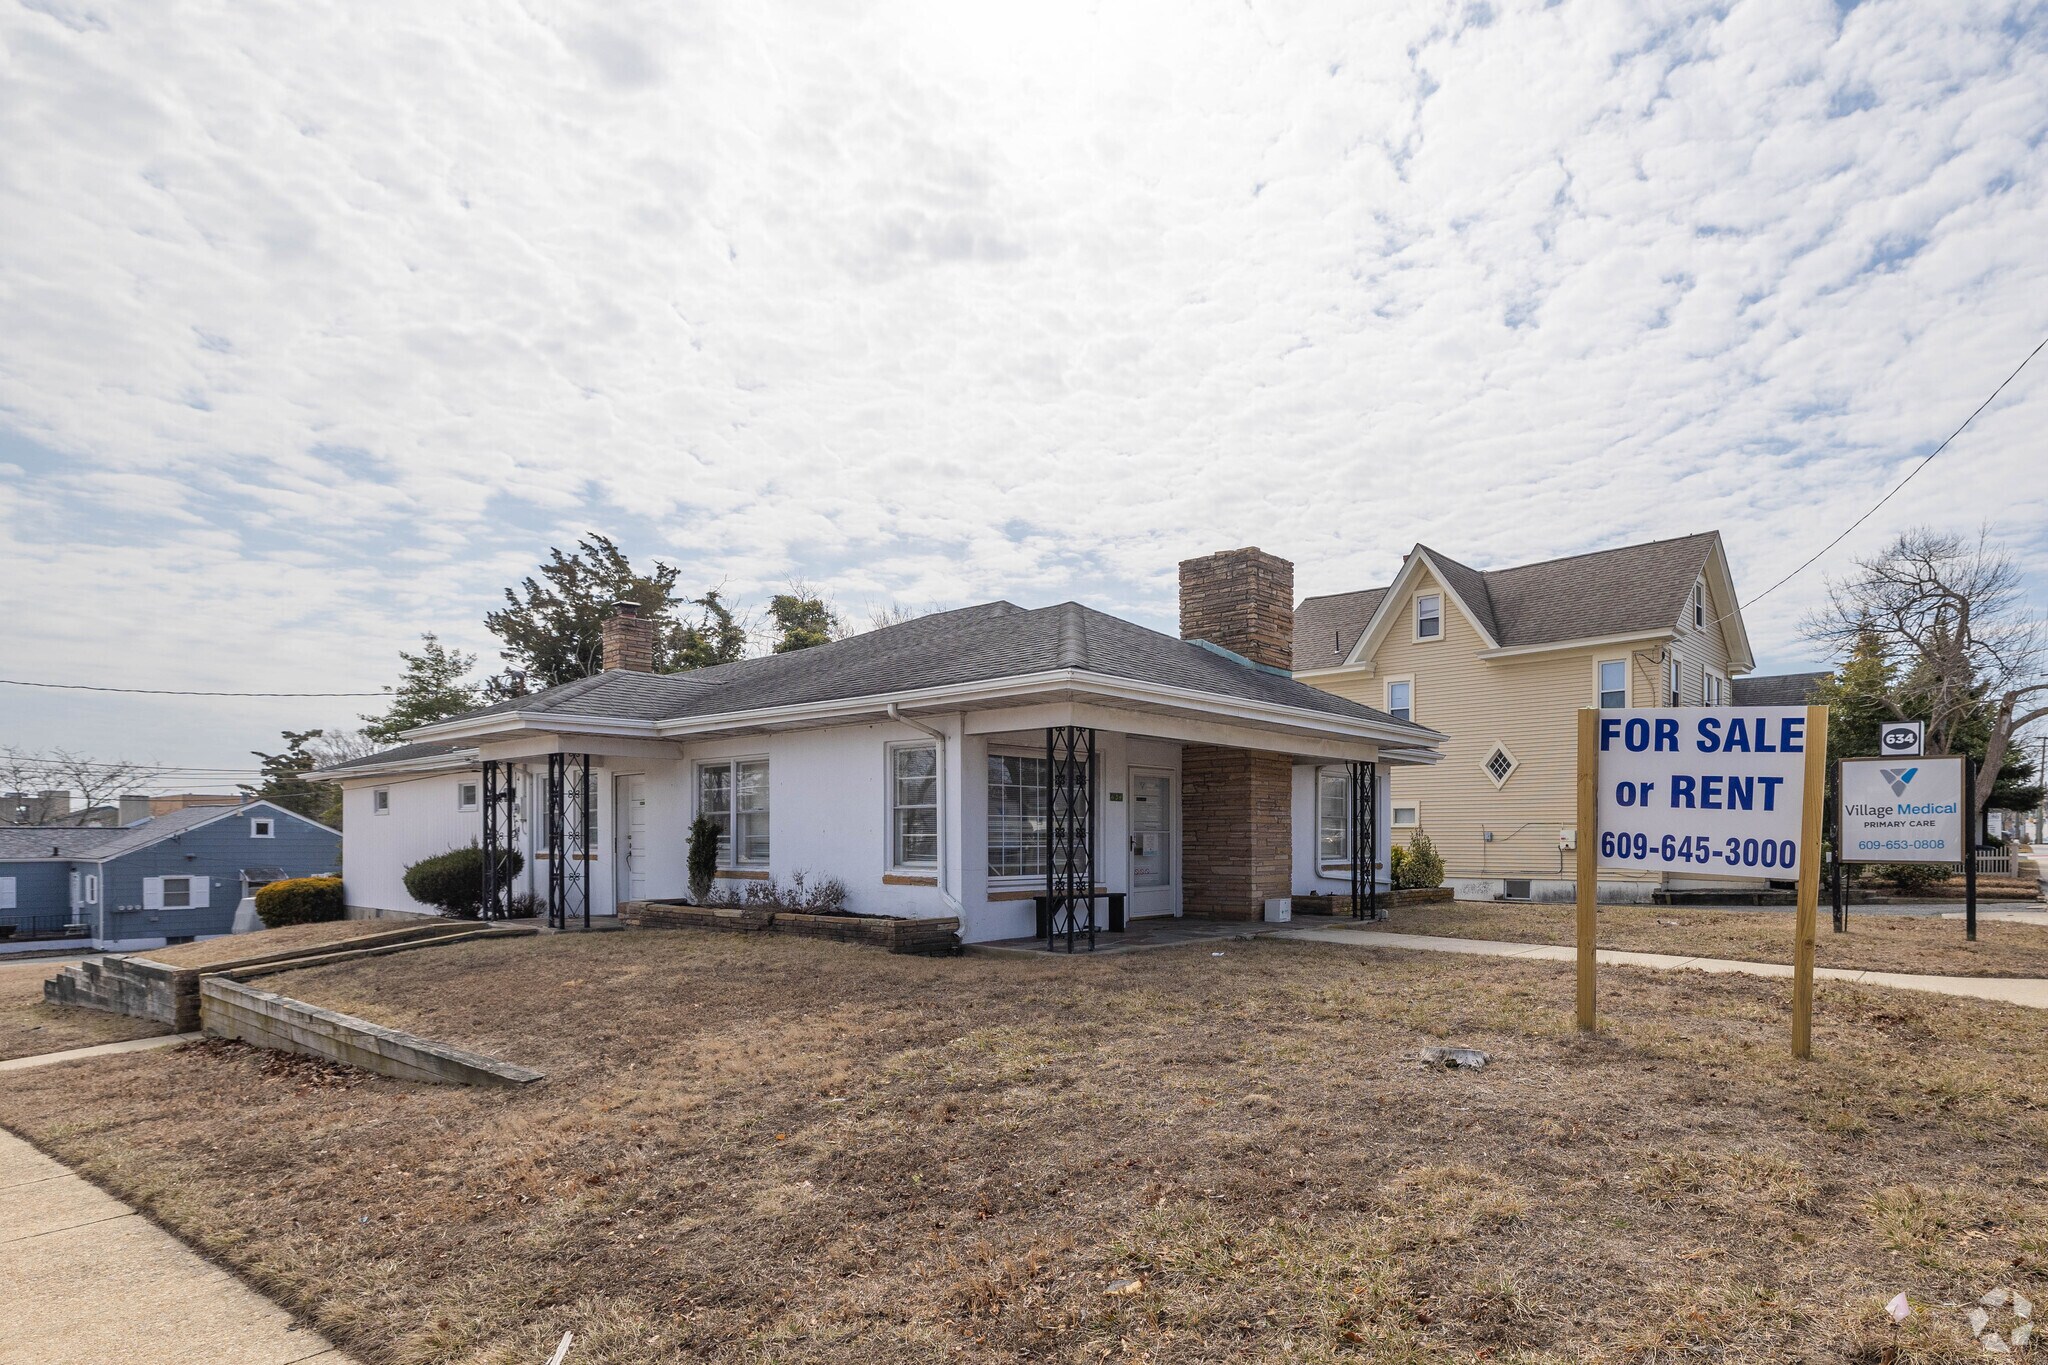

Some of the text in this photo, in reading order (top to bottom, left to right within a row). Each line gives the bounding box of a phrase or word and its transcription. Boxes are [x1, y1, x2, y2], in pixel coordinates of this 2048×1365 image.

[1601, 717, 1805, 752] FOR SALE
[1885, 733, 1915, 744] 634
[1616, 775, 1783, 811] or RENT
[1845, 802, 1957, 818] Village Medical
[1601, 831, 1796, 869] 609-645-3000
[1858, 839, 1945, 850] 609-653-0808
